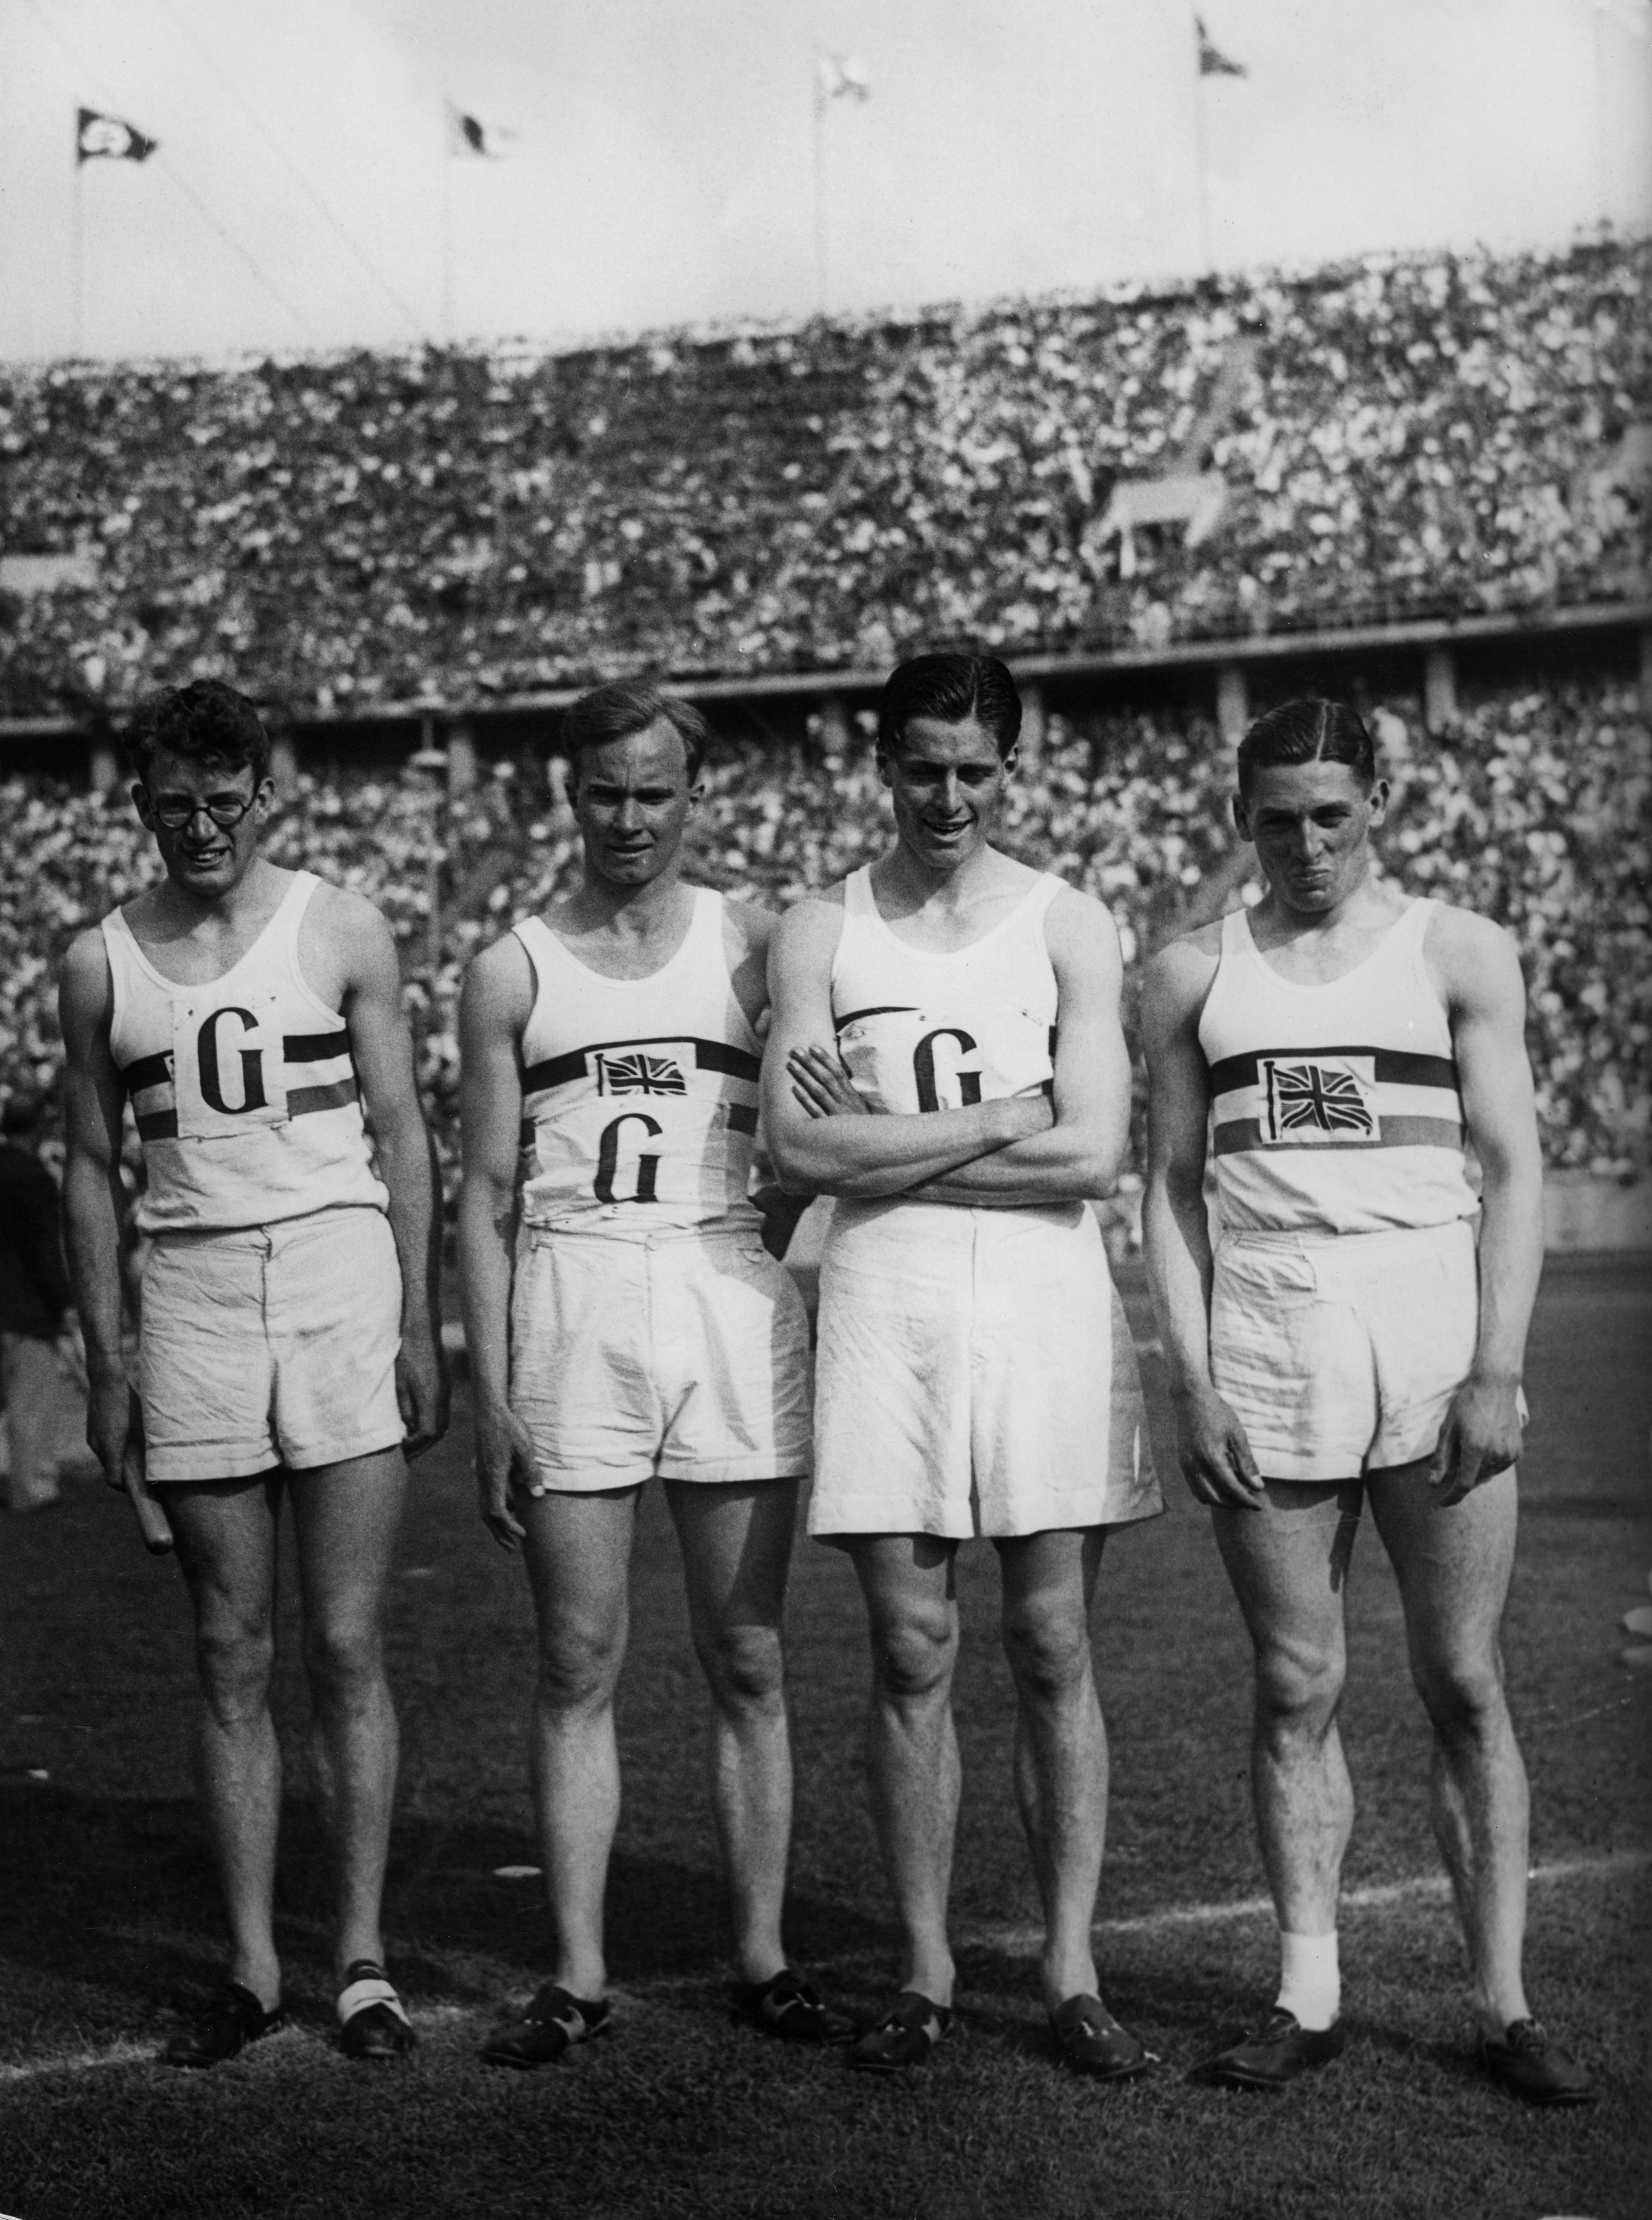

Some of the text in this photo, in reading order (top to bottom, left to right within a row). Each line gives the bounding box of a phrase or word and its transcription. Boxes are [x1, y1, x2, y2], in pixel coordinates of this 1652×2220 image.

[197, 1007, 269, 1114] G
[913, 1028, 983, 1113] G
[593, 1113, 662, 1203] G
